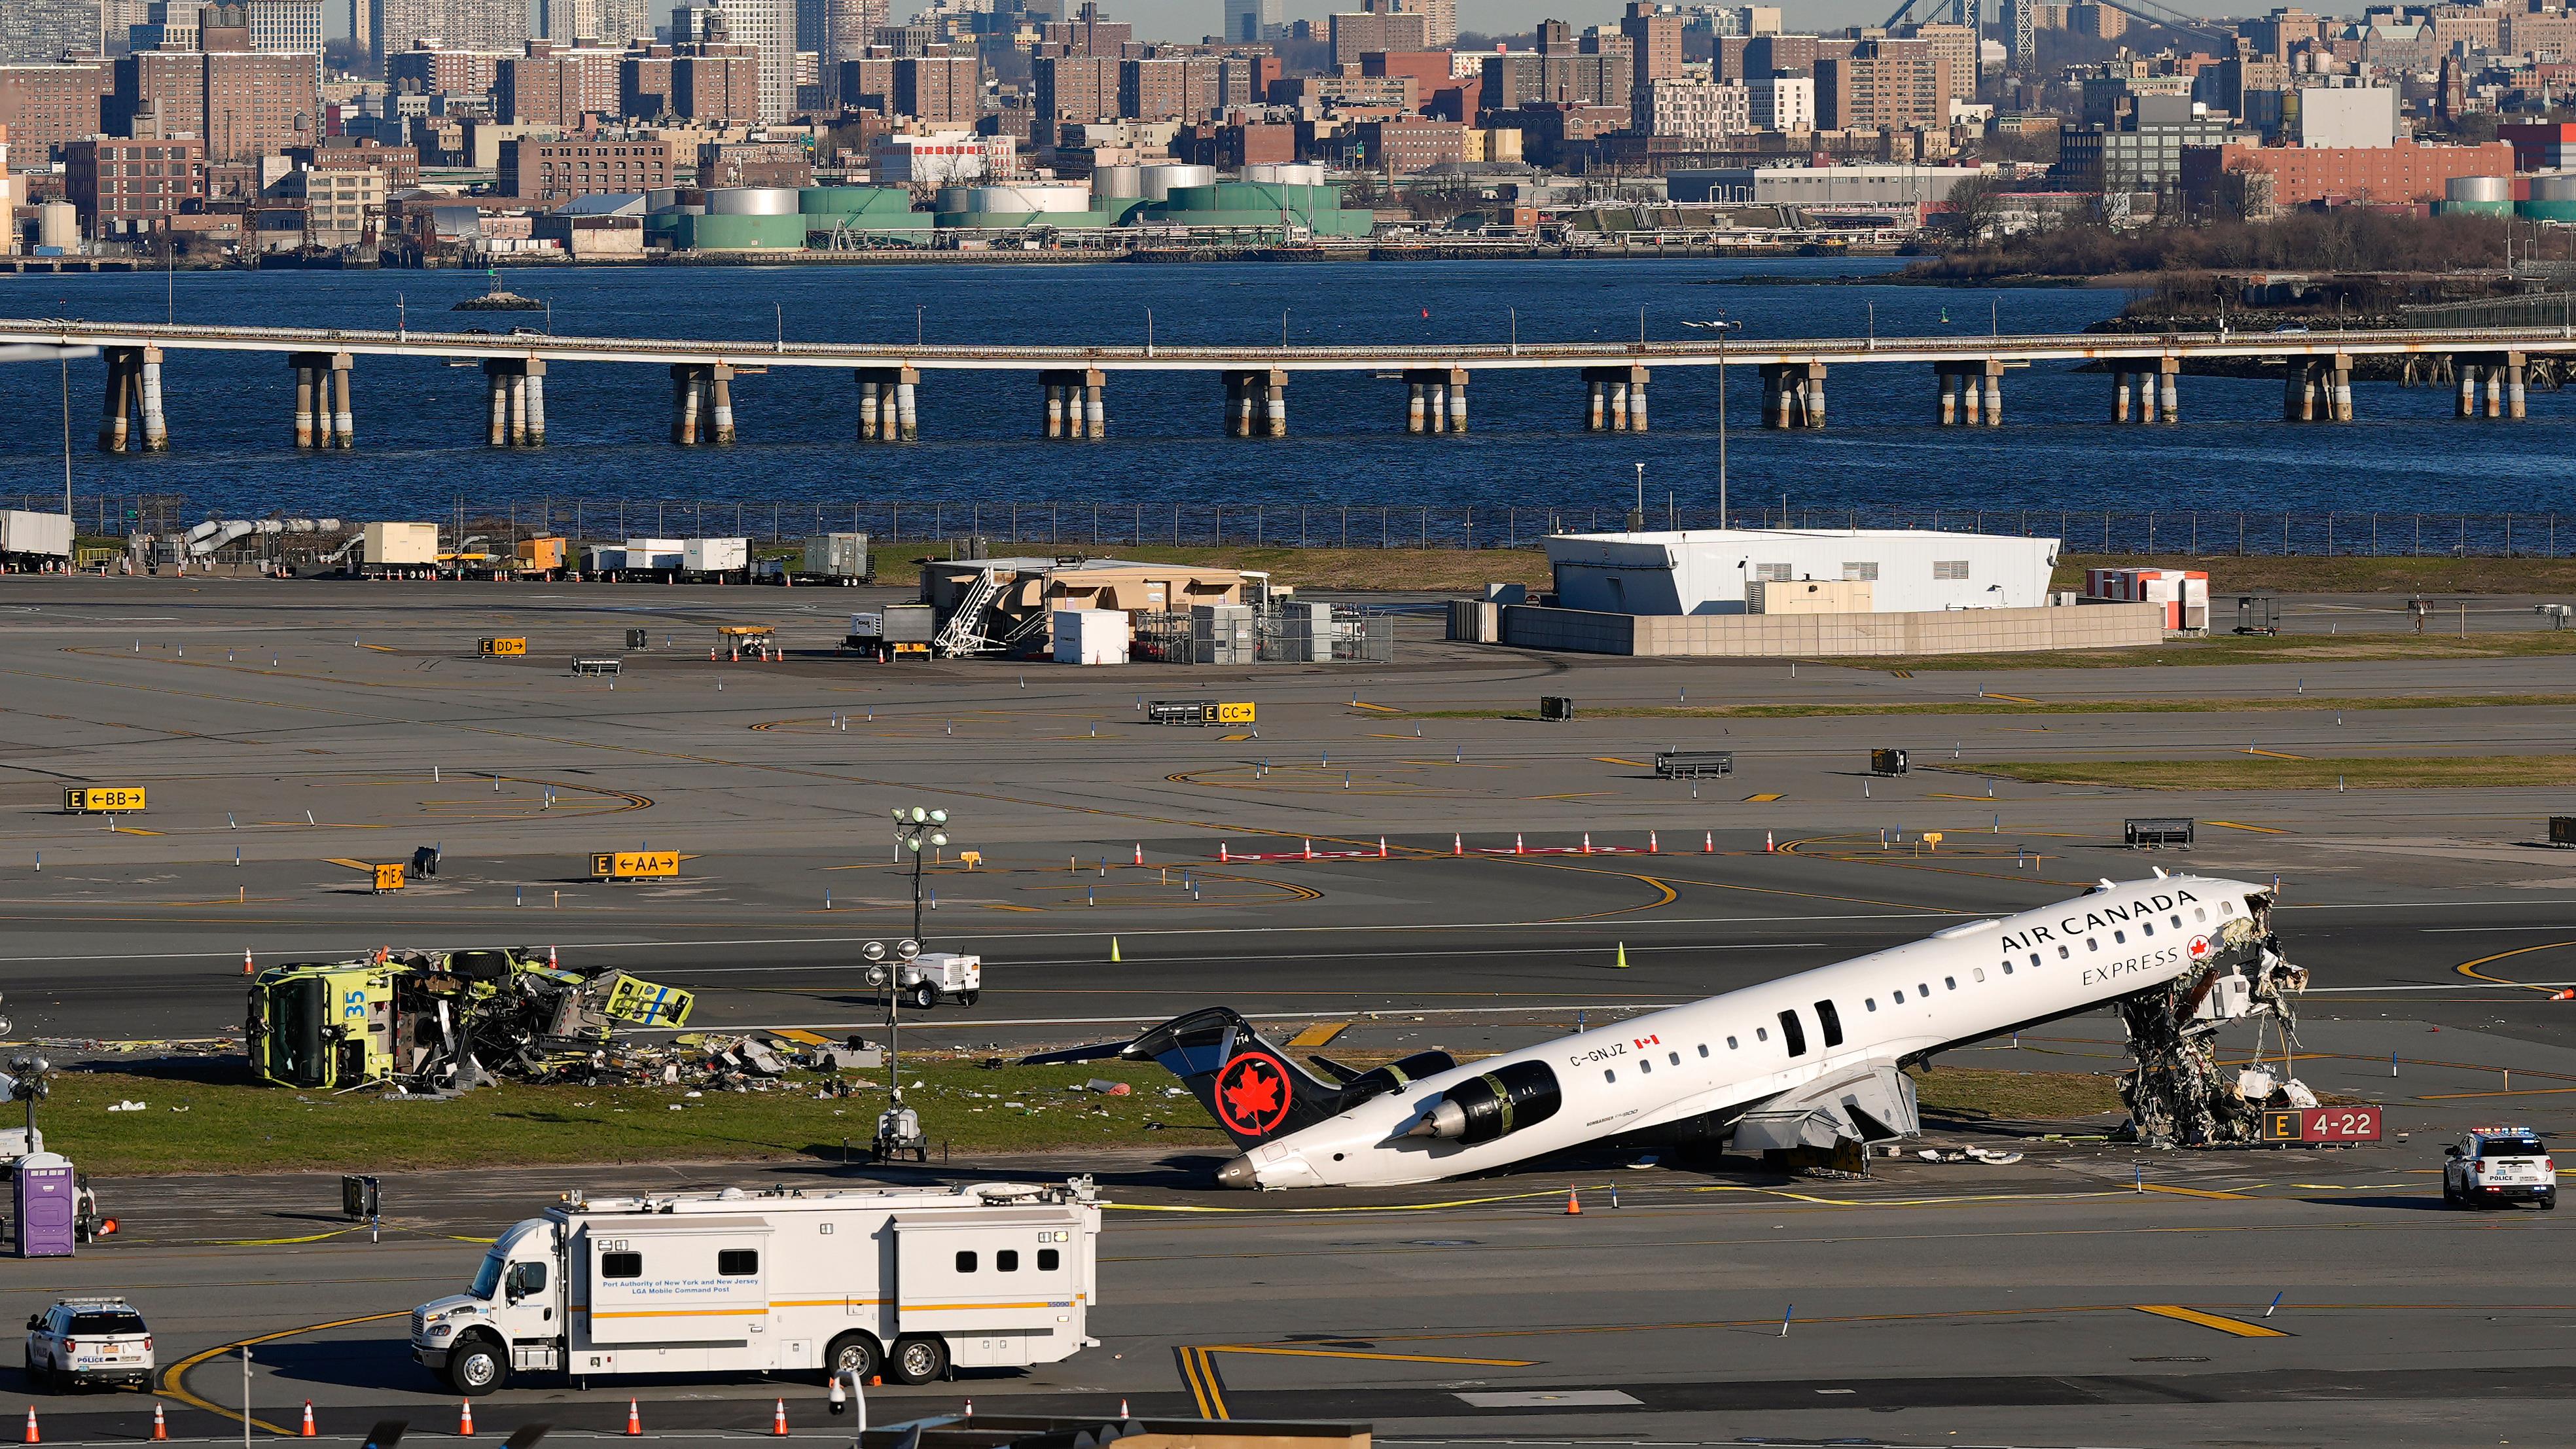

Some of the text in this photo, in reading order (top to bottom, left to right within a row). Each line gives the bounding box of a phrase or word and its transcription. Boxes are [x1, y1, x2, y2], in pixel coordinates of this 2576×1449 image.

[484, 641, 512, 652] E DD
[1206, 707, 1238, 719] E CC
[71, 792, 126, 806] E BB
[598, 857, 658, 872] E AA
[376, 869, 396, 884] F E
[2001, 890, 2198, 953] AIR CANADA
[2083, 947, 2178, 986] EXPRESS
[346, 991, 365, 1018] 35
[1235, 1034, 1249, 1045] 714
[1570, 1043, 1627, 1066] C-GNJZ
[2276, 1113, 2370, 1136] E 4-22
